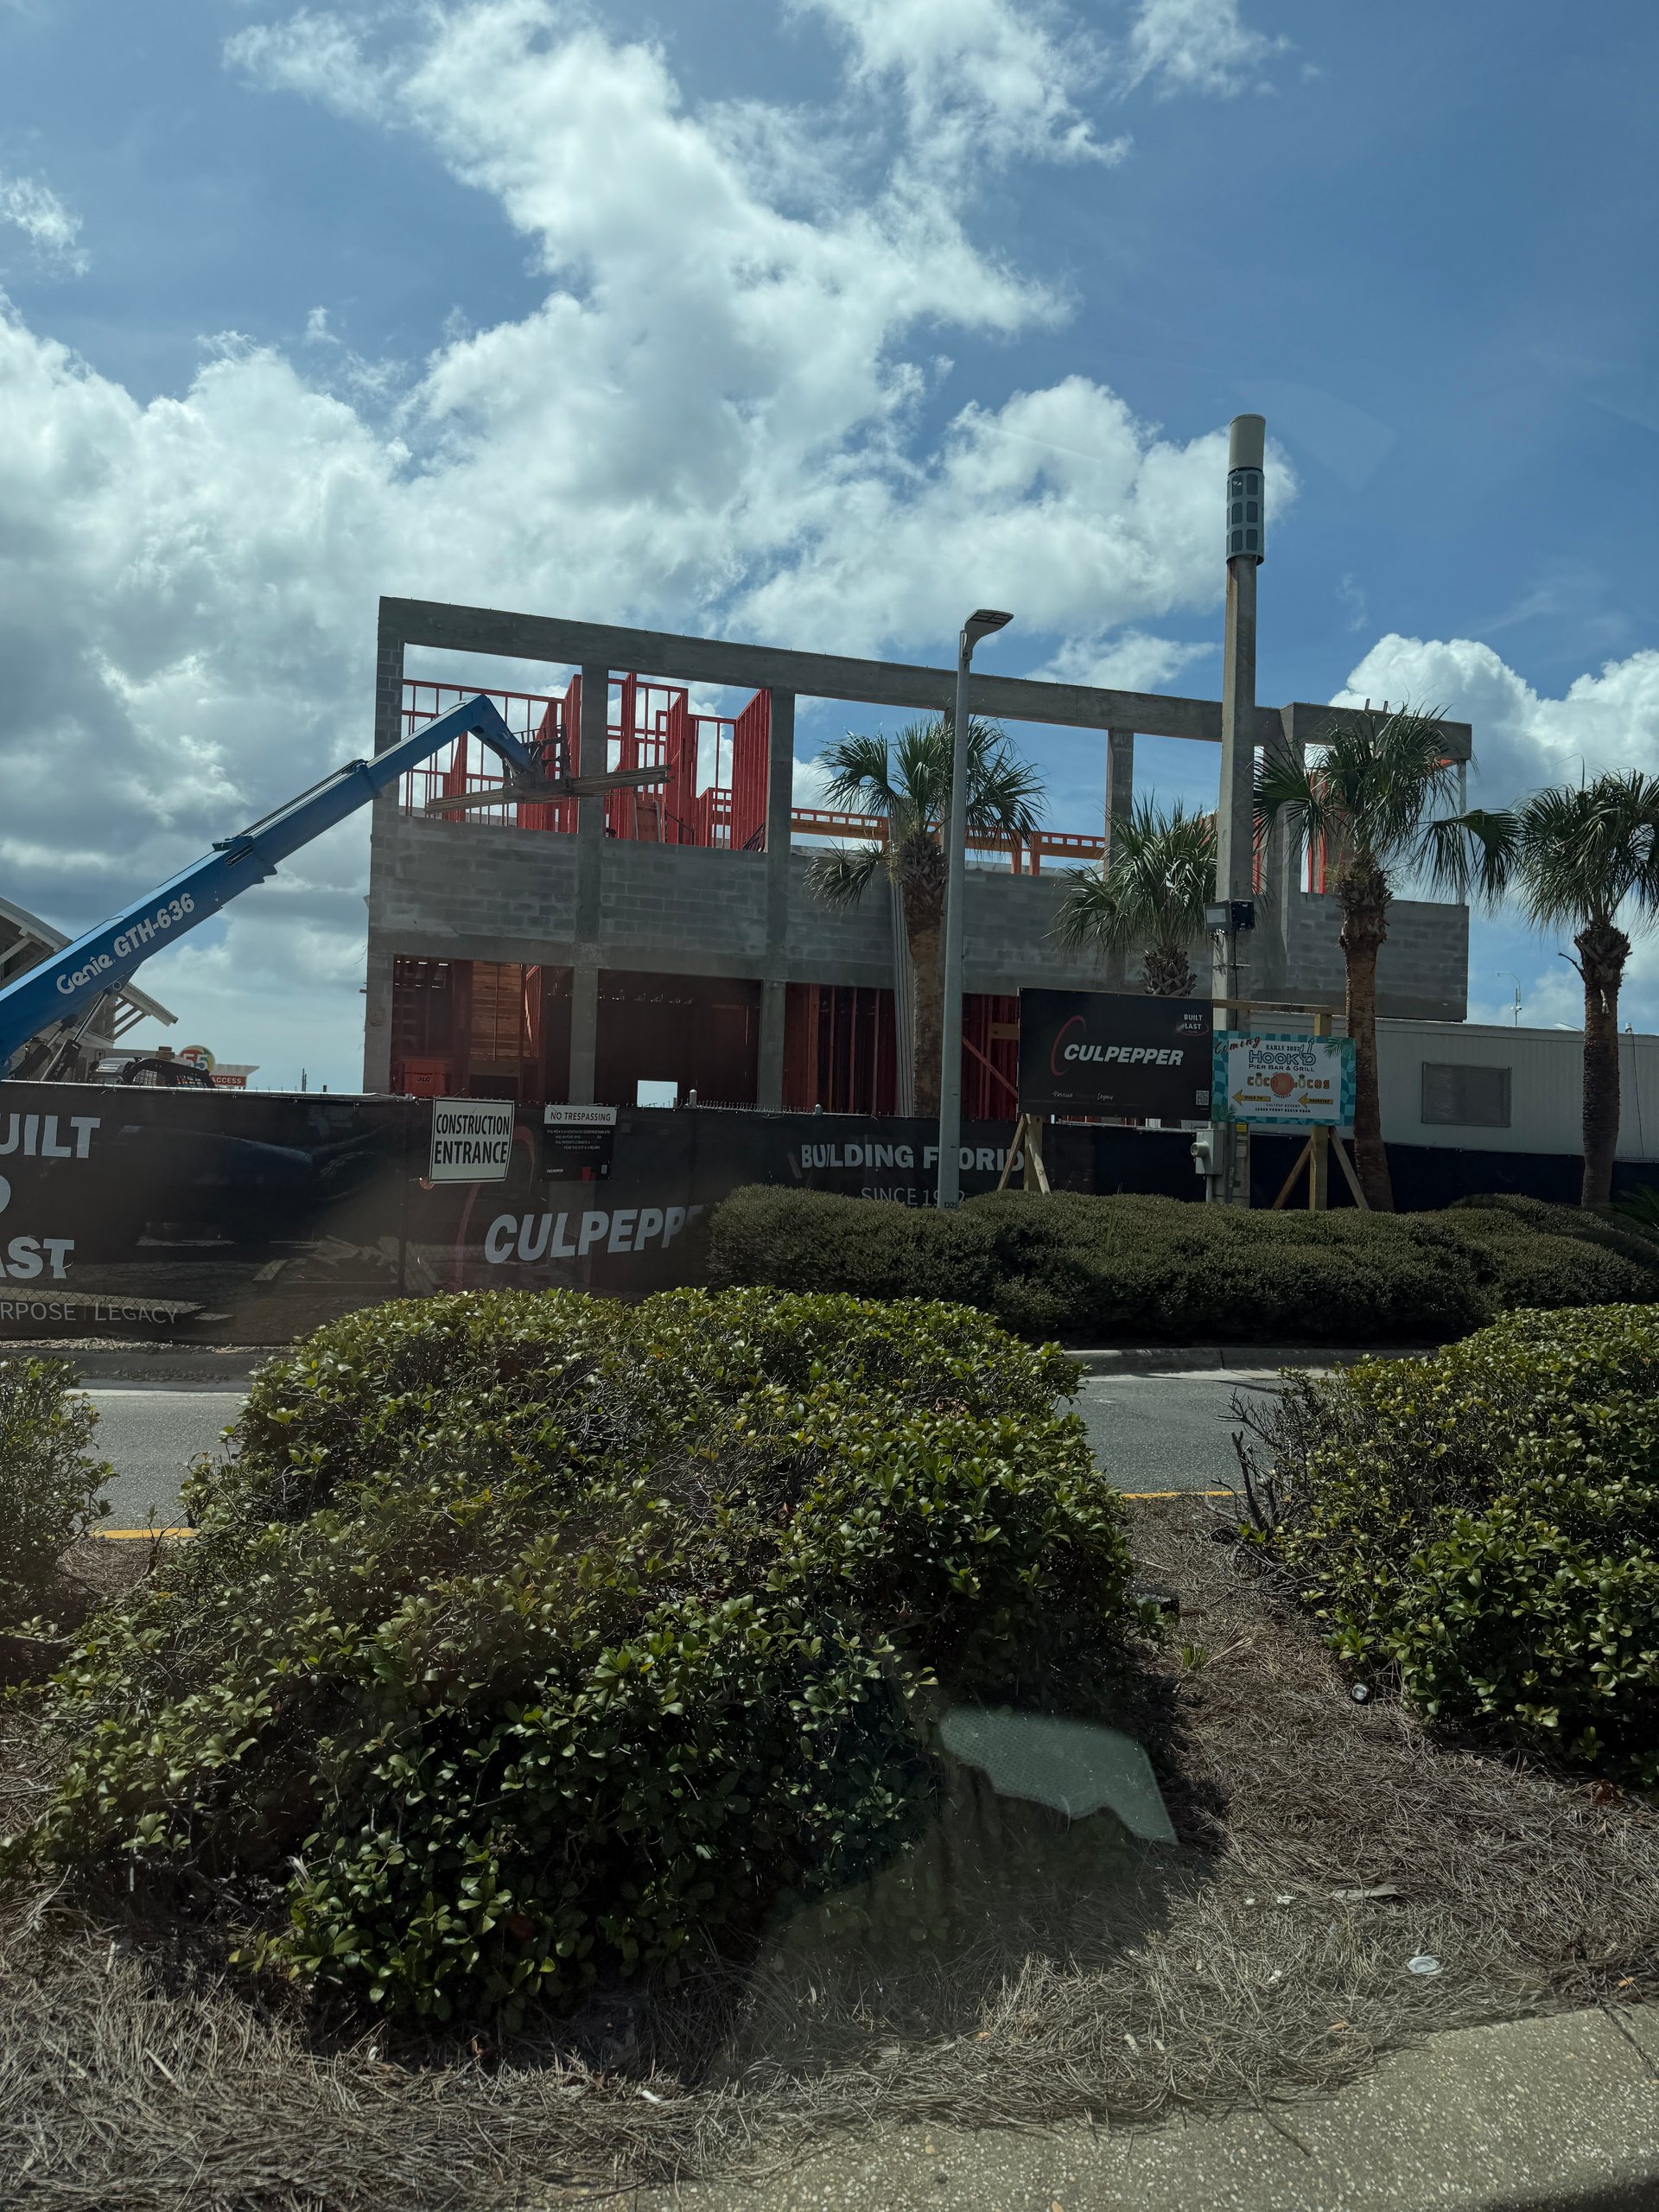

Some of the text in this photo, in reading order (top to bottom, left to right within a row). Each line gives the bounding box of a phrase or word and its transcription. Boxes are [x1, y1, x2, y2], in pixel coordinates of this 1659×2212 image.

[56, 893, 195, 995] Genie GTH-636
[1064, 1044, 1185, 1066] CULPEPPER
[1215, 1037, 1261, 1054] Coming
[182, 1053, 208, 1071] 55
[436, 1114, 510, 1135] CONSTRUCTION
[550, 1111, 611, 1122] NO TRESPASSING
[0, 1113, 101, 1159] UILT
[434, 1141, 508, 1164] ENTRANCE
[802, 1143, 914, 1168] BUILDING
[0, 1302, 178, 1325] RPOSE LEGACY
